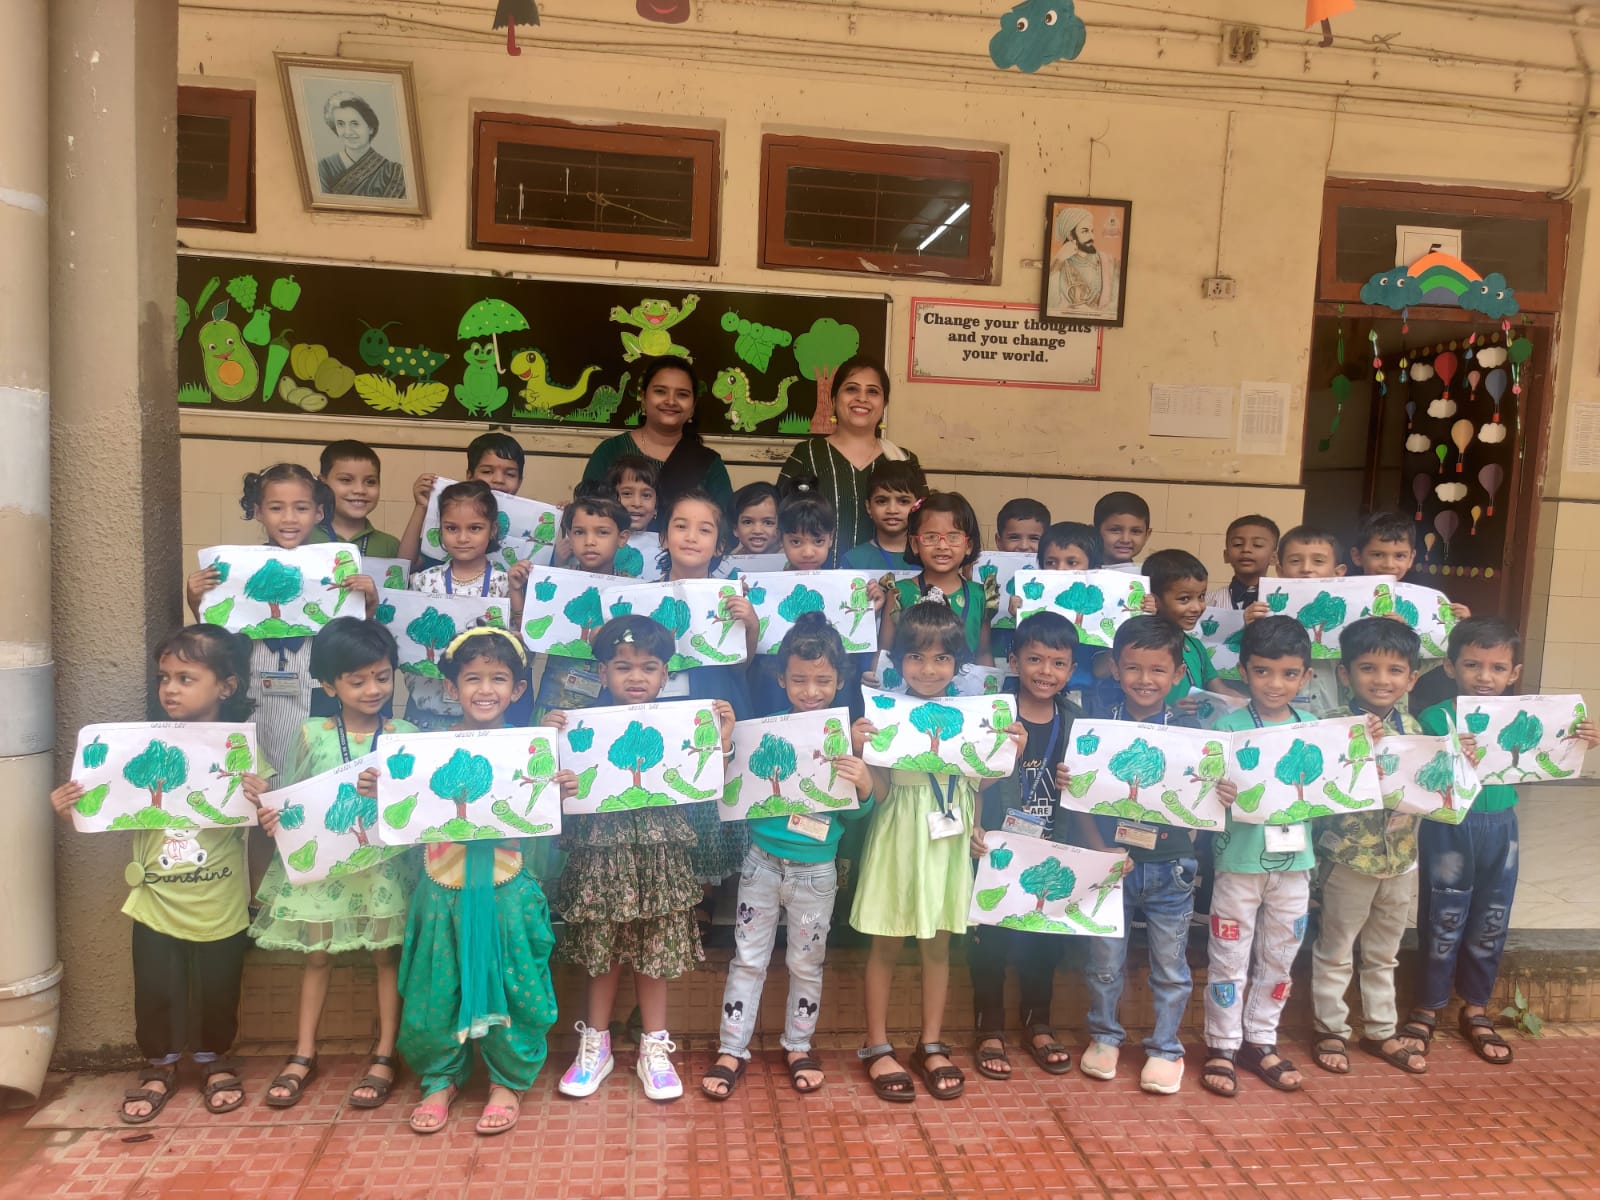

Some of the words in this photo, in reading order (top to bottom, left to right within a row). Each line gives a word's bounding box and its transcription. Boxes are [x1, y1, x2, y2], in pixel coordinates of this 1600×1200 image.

[923, 312, 980, 329] Change
[985, 319, 1019, 330] your
[948, 331, 976, 343] and
[980, 336, 1008, 346] you
[1012, 336, 1066, 350] change
[962, 348, 998, 361] your
[1002, 350, 1049, 363] world.
[144, 866, 233, 884] Sunshine
[1221, 924, 1239, 938] 25
